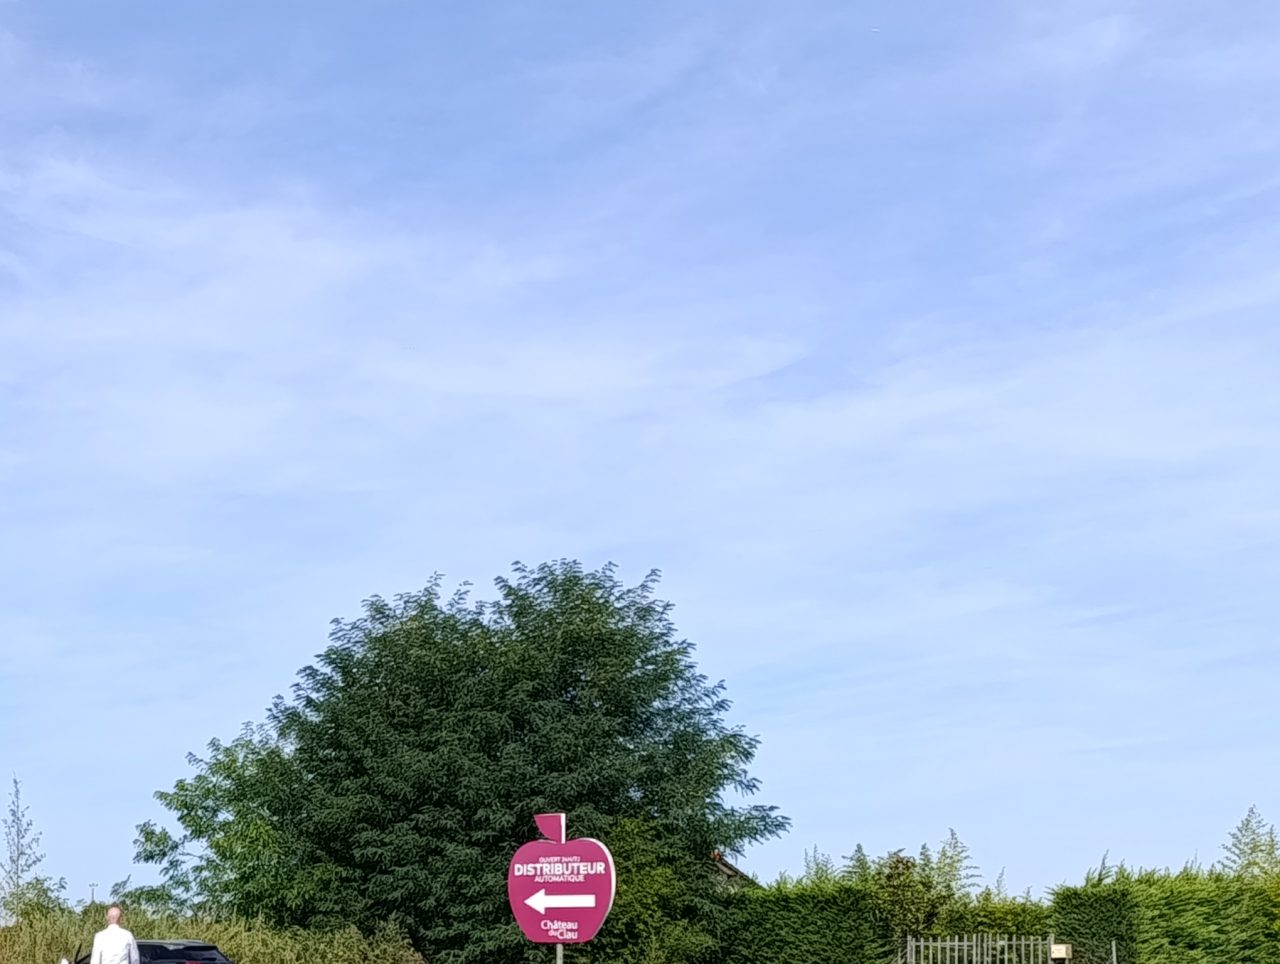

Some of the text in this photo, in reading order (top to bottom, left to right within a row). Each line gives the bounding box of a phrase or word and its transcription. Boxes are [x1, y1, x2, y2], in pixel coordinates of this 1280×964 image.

[514, 861, 606, 876] DISTRIBUTEUR
[534, 874, 585, 883] AUTOMATIQUE
[540, 919, 578, 931] Château
[557, 929, 578, 940] Clau
